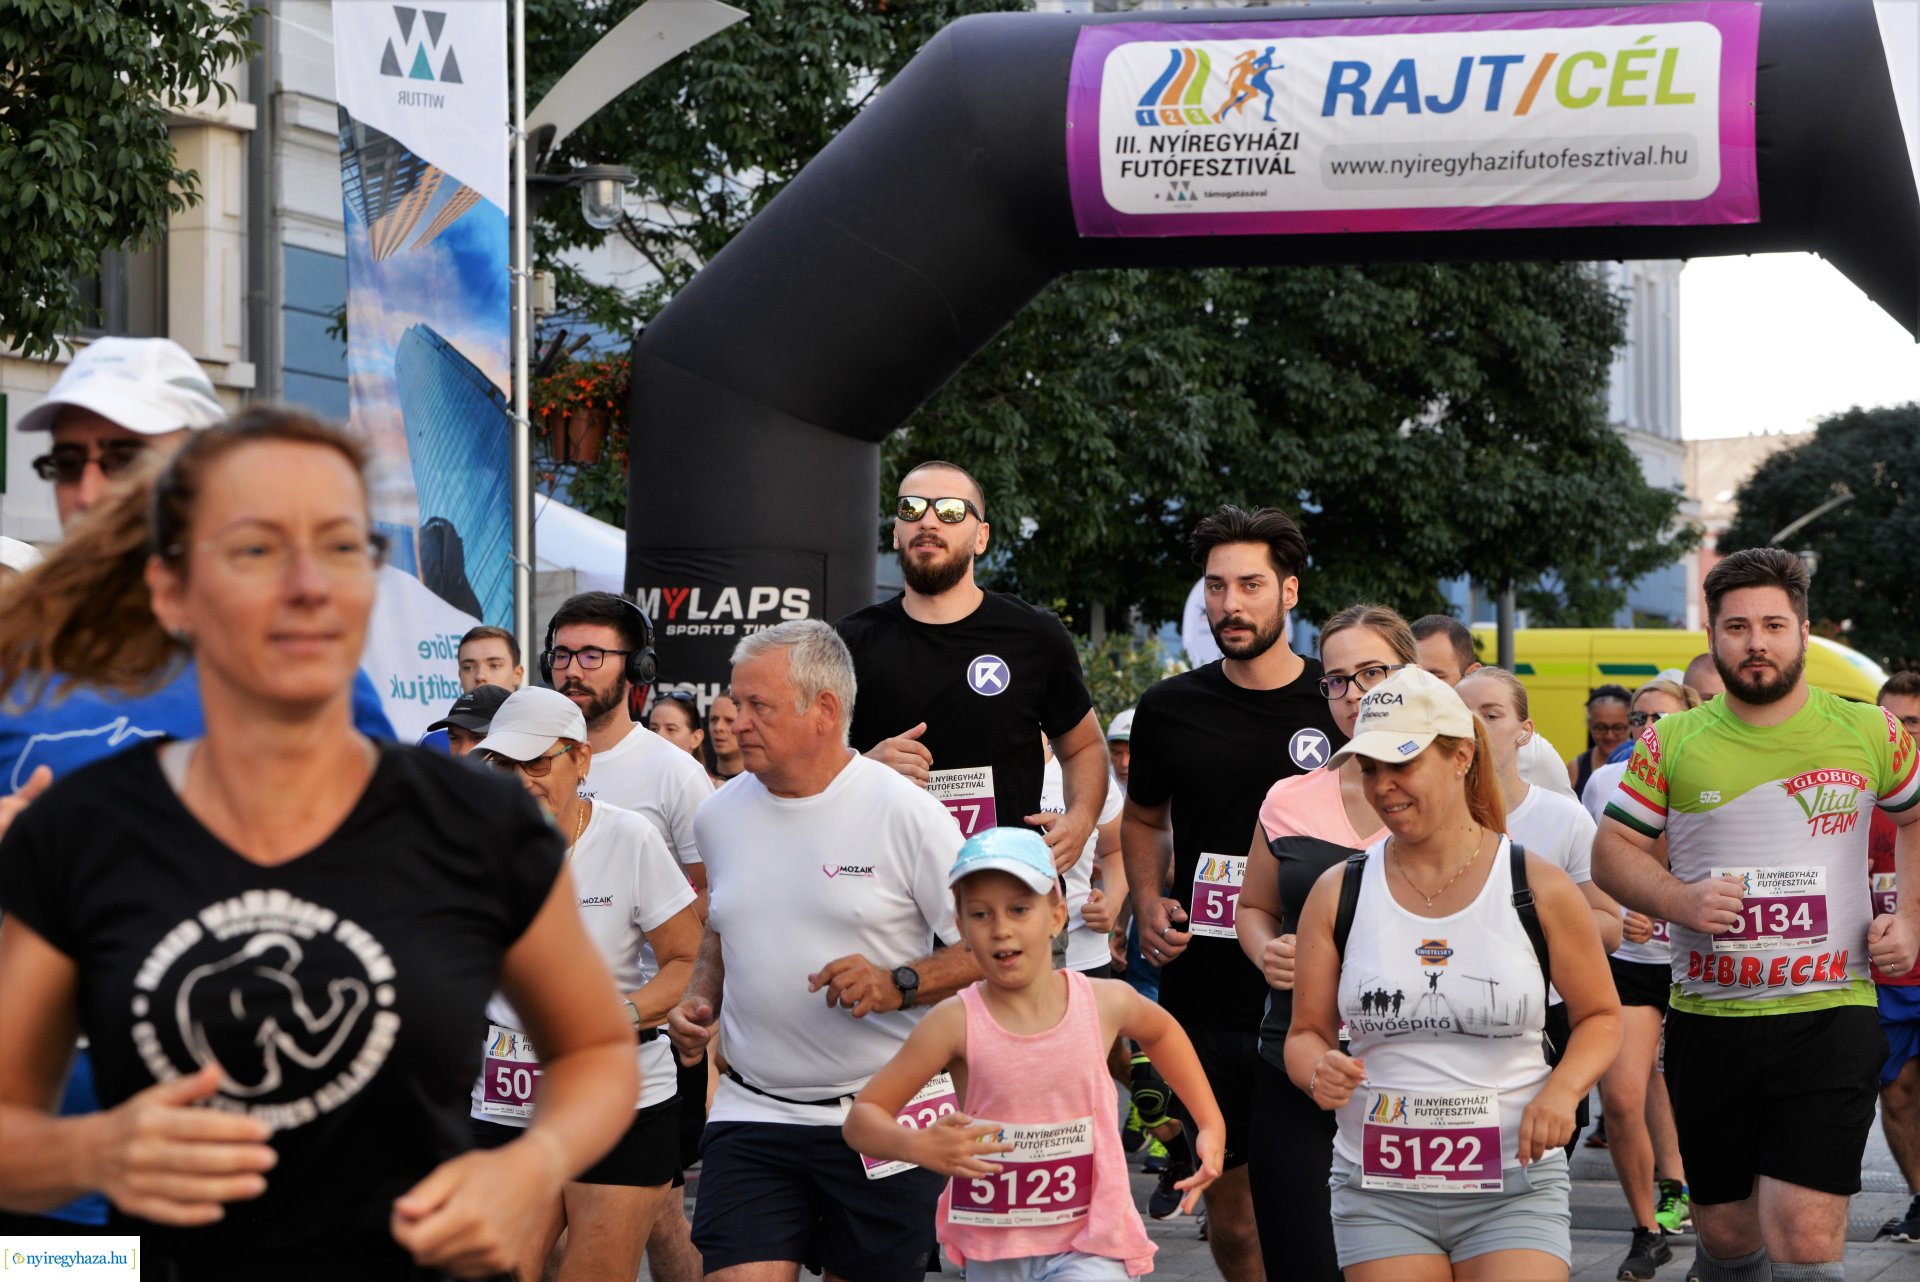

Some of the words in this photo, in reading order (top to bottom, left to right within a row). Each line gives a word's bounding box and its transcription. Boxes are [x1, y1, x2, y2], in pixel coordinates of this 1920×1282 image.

[1321, 35, 1697, 117] RAJT/CÉL
[1115, 136, 1141, 154] III.
[1149, 128, 1299, 153] NYÍREGYHÁZI
[1120, 153, 1296, 178] FUTÓFESZTIVÁL
[1331, 145, 1688, 178] www.nyiregyhazifutofesztival.hu
[636, 587, 811, 620] MYLAPS
[666, 624, 735, 636] SPORTS
[1793, 770, 1861, 789] GLOBUS
[1795, 786, 1857, 820] Vital
[1808, 811, 1858, 837] TEAM
[840, 865, 873, 873] MOZAIK
[582, 896, 612, 904] MOZAIK
[1206, 890, 1240, 921] 51
[1687, 949, 1849, 989] DEBRECEN
[1360, 1016, 1451, 1035] jövőépítő
[1415, 1105, 1489, 1116] FUTÓFESZTIVÁL
[1014, 1134, 1086, 1150] FUTÓFESZTIVÁL
[1379, 1134, 1483, 1172] 5122
[970, 1165, 1076, 1205] 5123
